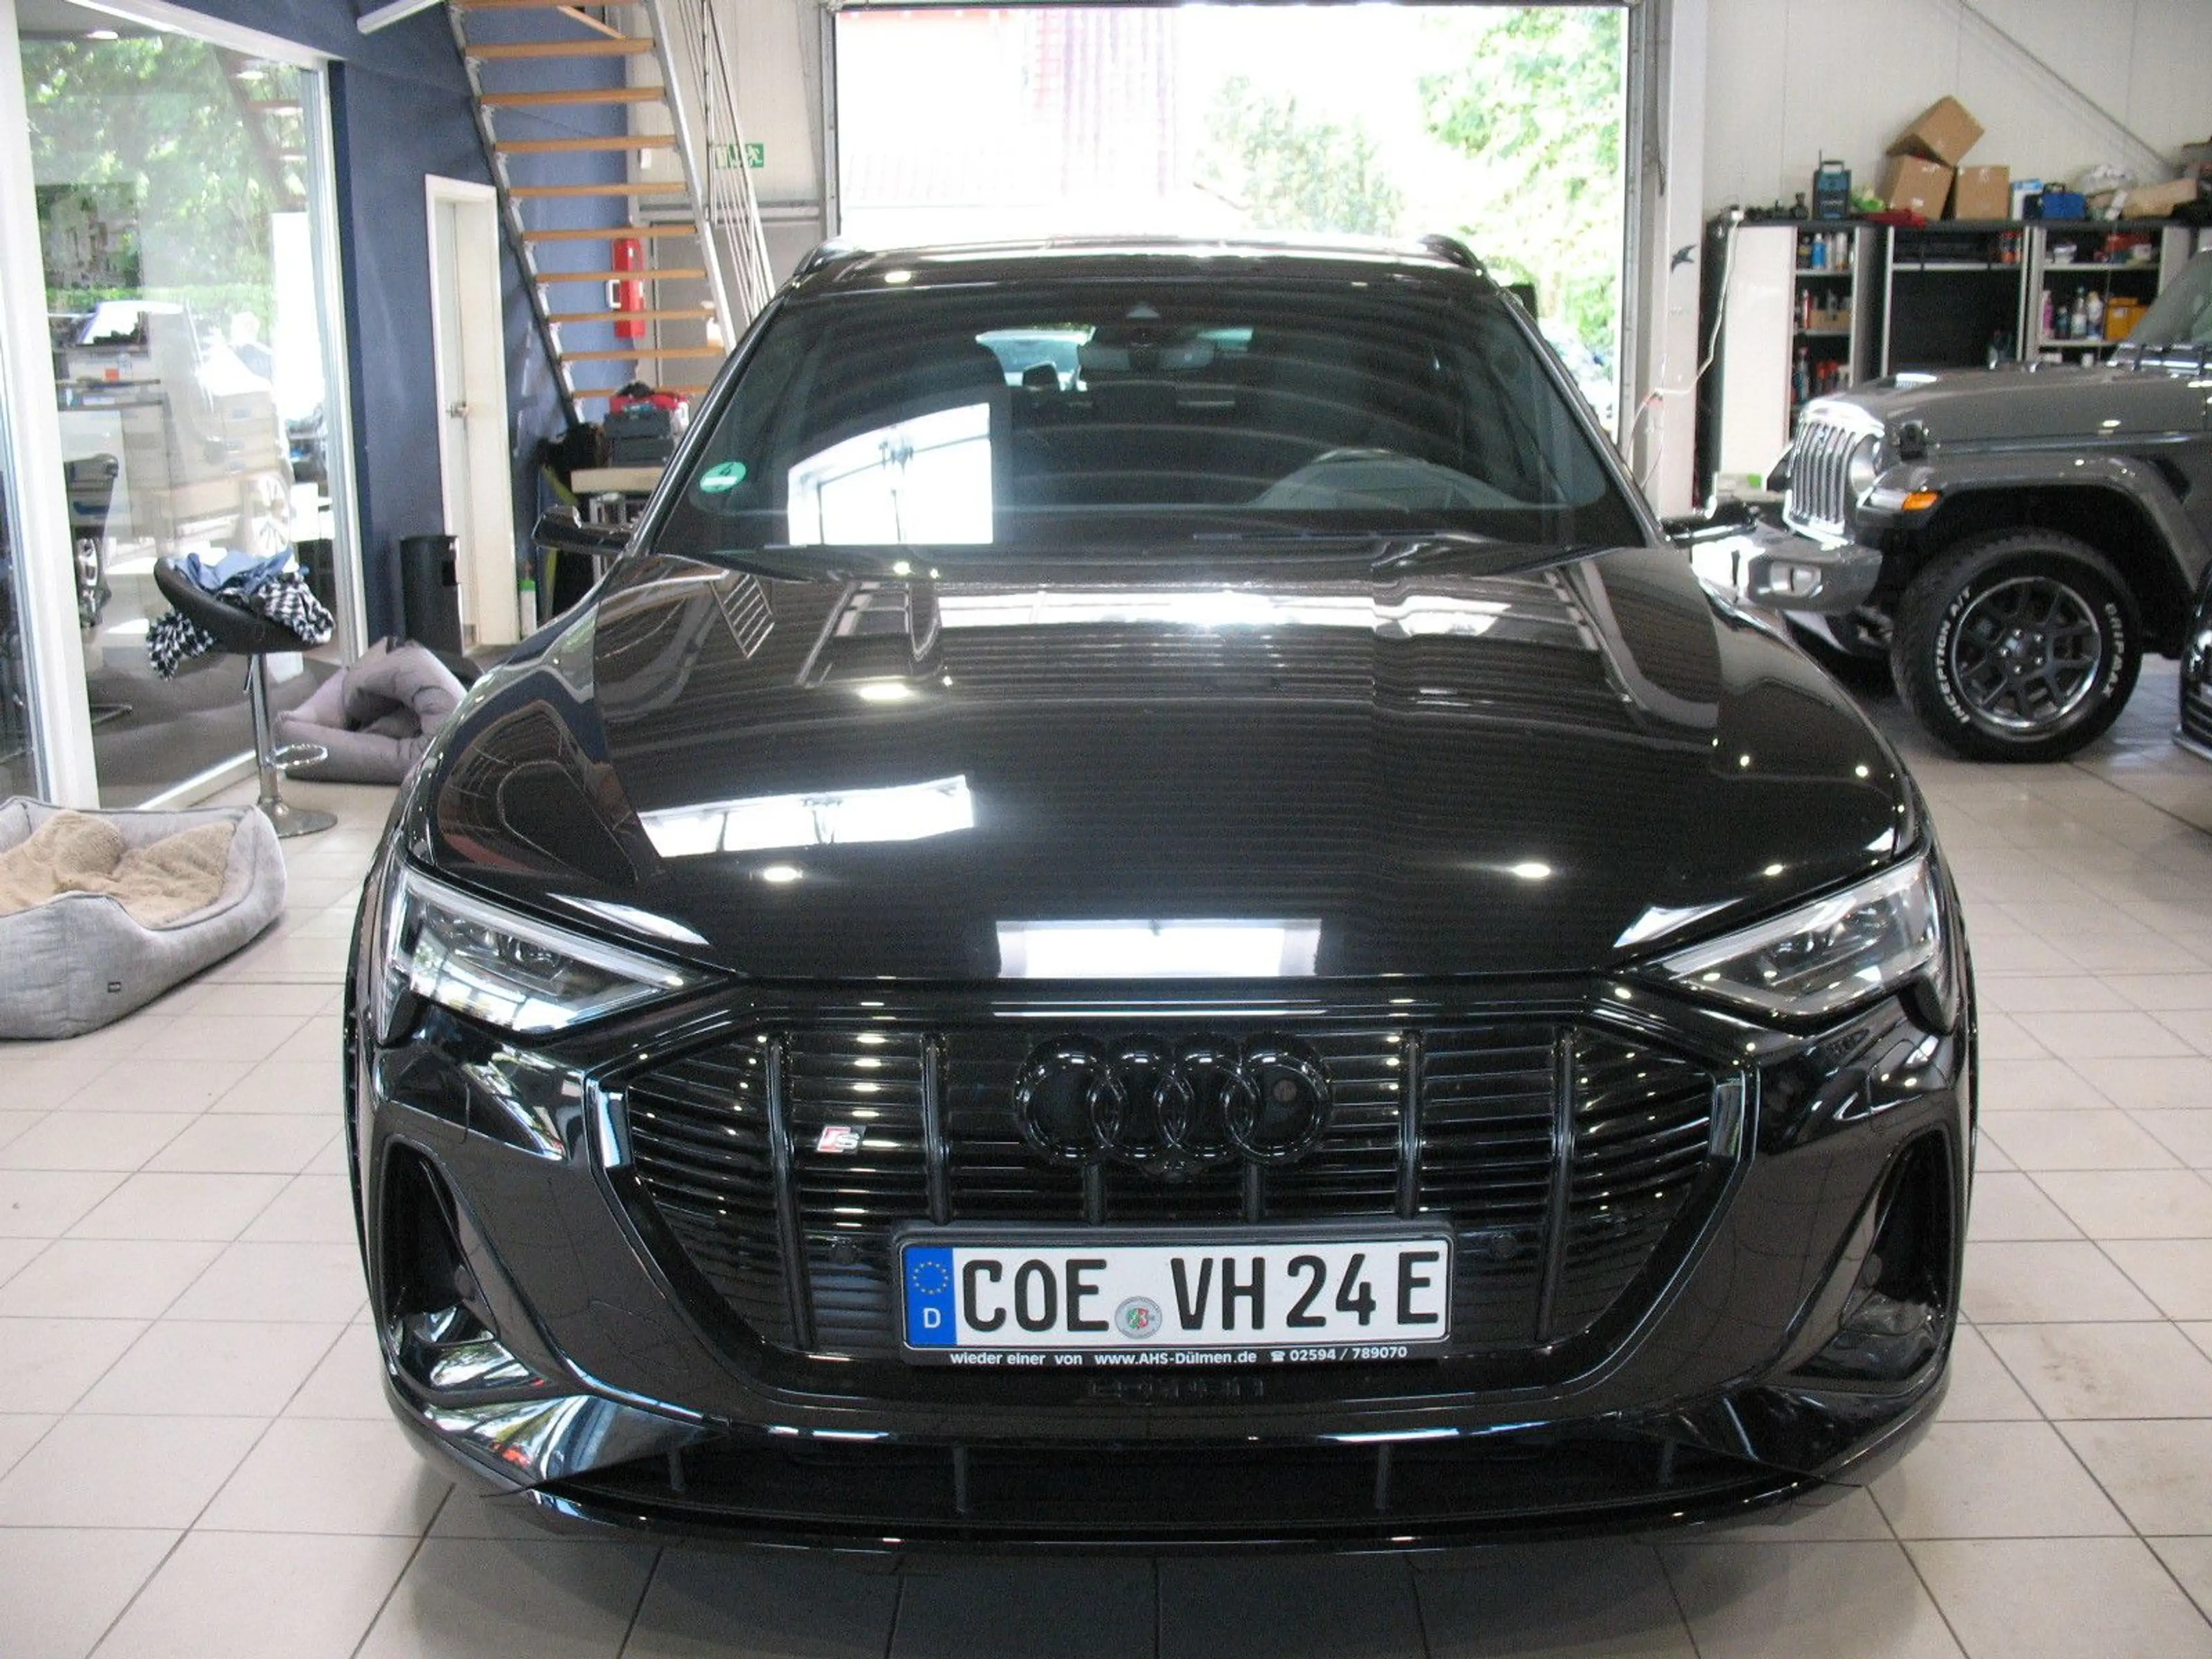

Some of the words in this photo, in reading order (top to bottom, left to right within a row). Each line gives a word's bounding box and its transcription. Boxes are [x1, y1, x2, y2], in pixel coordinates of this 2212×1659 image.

[1936, 620, 1971, 724] INCEPTION
[923, 1307, 941, 1328] D
[963, 1259, 1109, 1332] COE
[1171, 1257, 1265, 1331] VH
[950, 1352, 1003, 1365] wieder
[1007, 1352, 1046, 1365] einer
[1054, 1354, 1082, 1365] von
[1094, 1351, 1257, 1365] www.AHS-Dülmen.de
[1289, 1348, 1336, 1362] 02594
[1339, 1348, 1349, 1361] /
[1352, 1346, 1408, 1359] 789070
